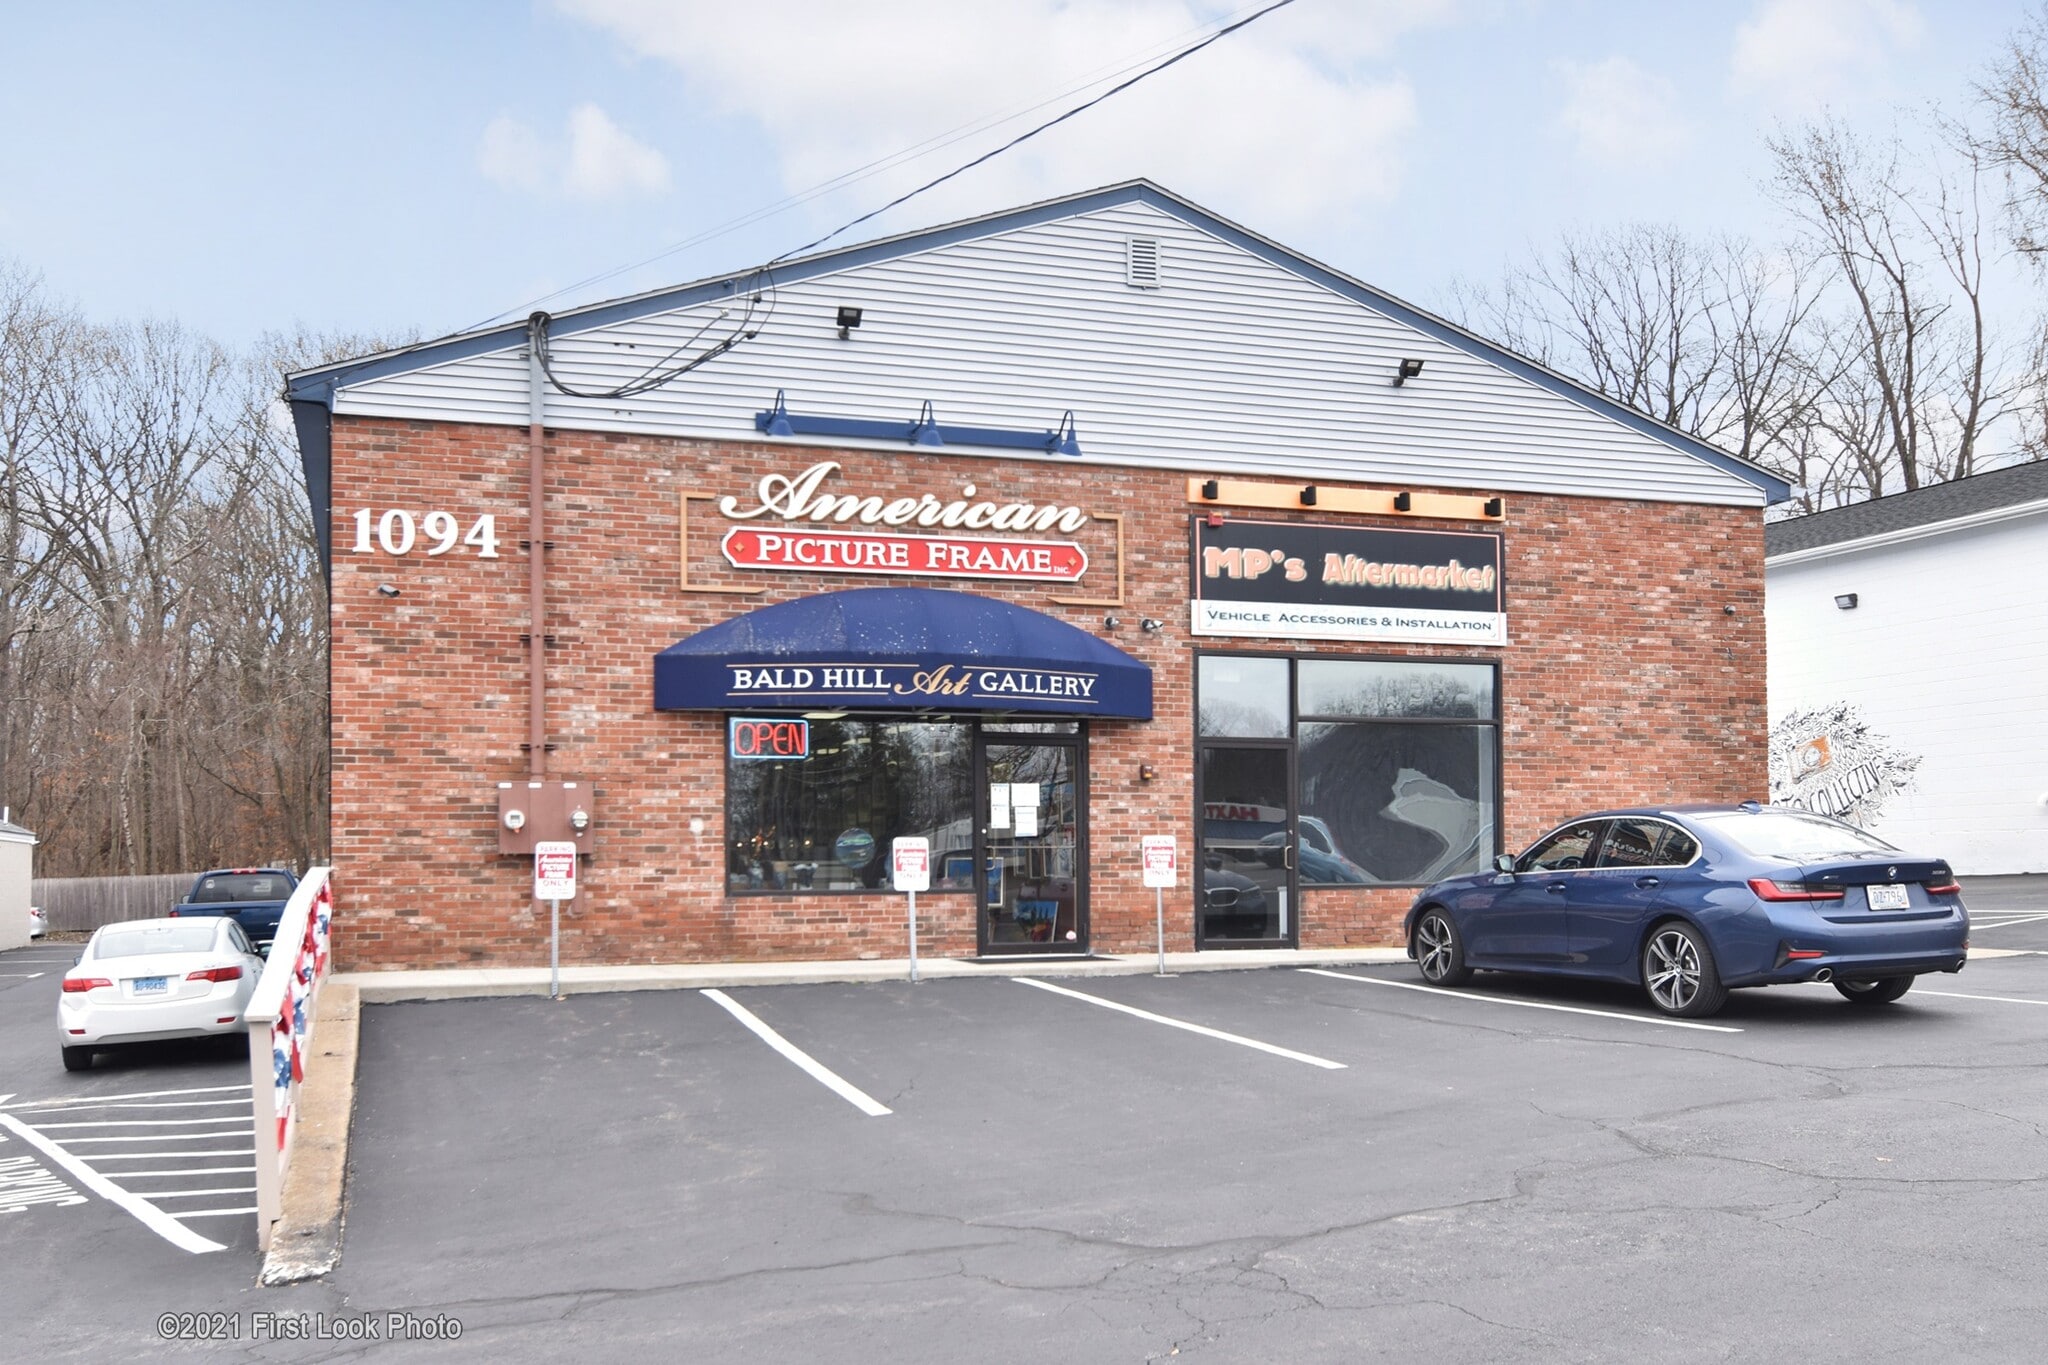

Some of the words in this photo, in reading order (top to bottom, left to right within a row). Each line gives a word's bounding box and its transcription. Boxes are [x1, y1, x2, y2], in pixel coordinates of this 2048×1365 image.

[720, 461, 1087, 533] American
[352, 508, 500, 558] 1094
[756, 534, 908, 567] PICTURE
[926, 542, 1052, 573] FRAME
[1203, 546, 1307, 582] MP's
[1322, 553, 1495, 592] Aftermarket
[1207, 610, 1271, 622] VEHICLE
[1278, 612, 1378, 626] ACCESSORIES
[1381, 616, 1392, 627] &
[1396, 617, 1492, 630] INSTALLATION
[733, 668, 814, 689] BALD
[822, 668, 892, 689] HILL
[894, 664, 972, 695] Art
[979, 672, 1096, 697] GALLERY
[735, 722, 806, 755] OPEN
